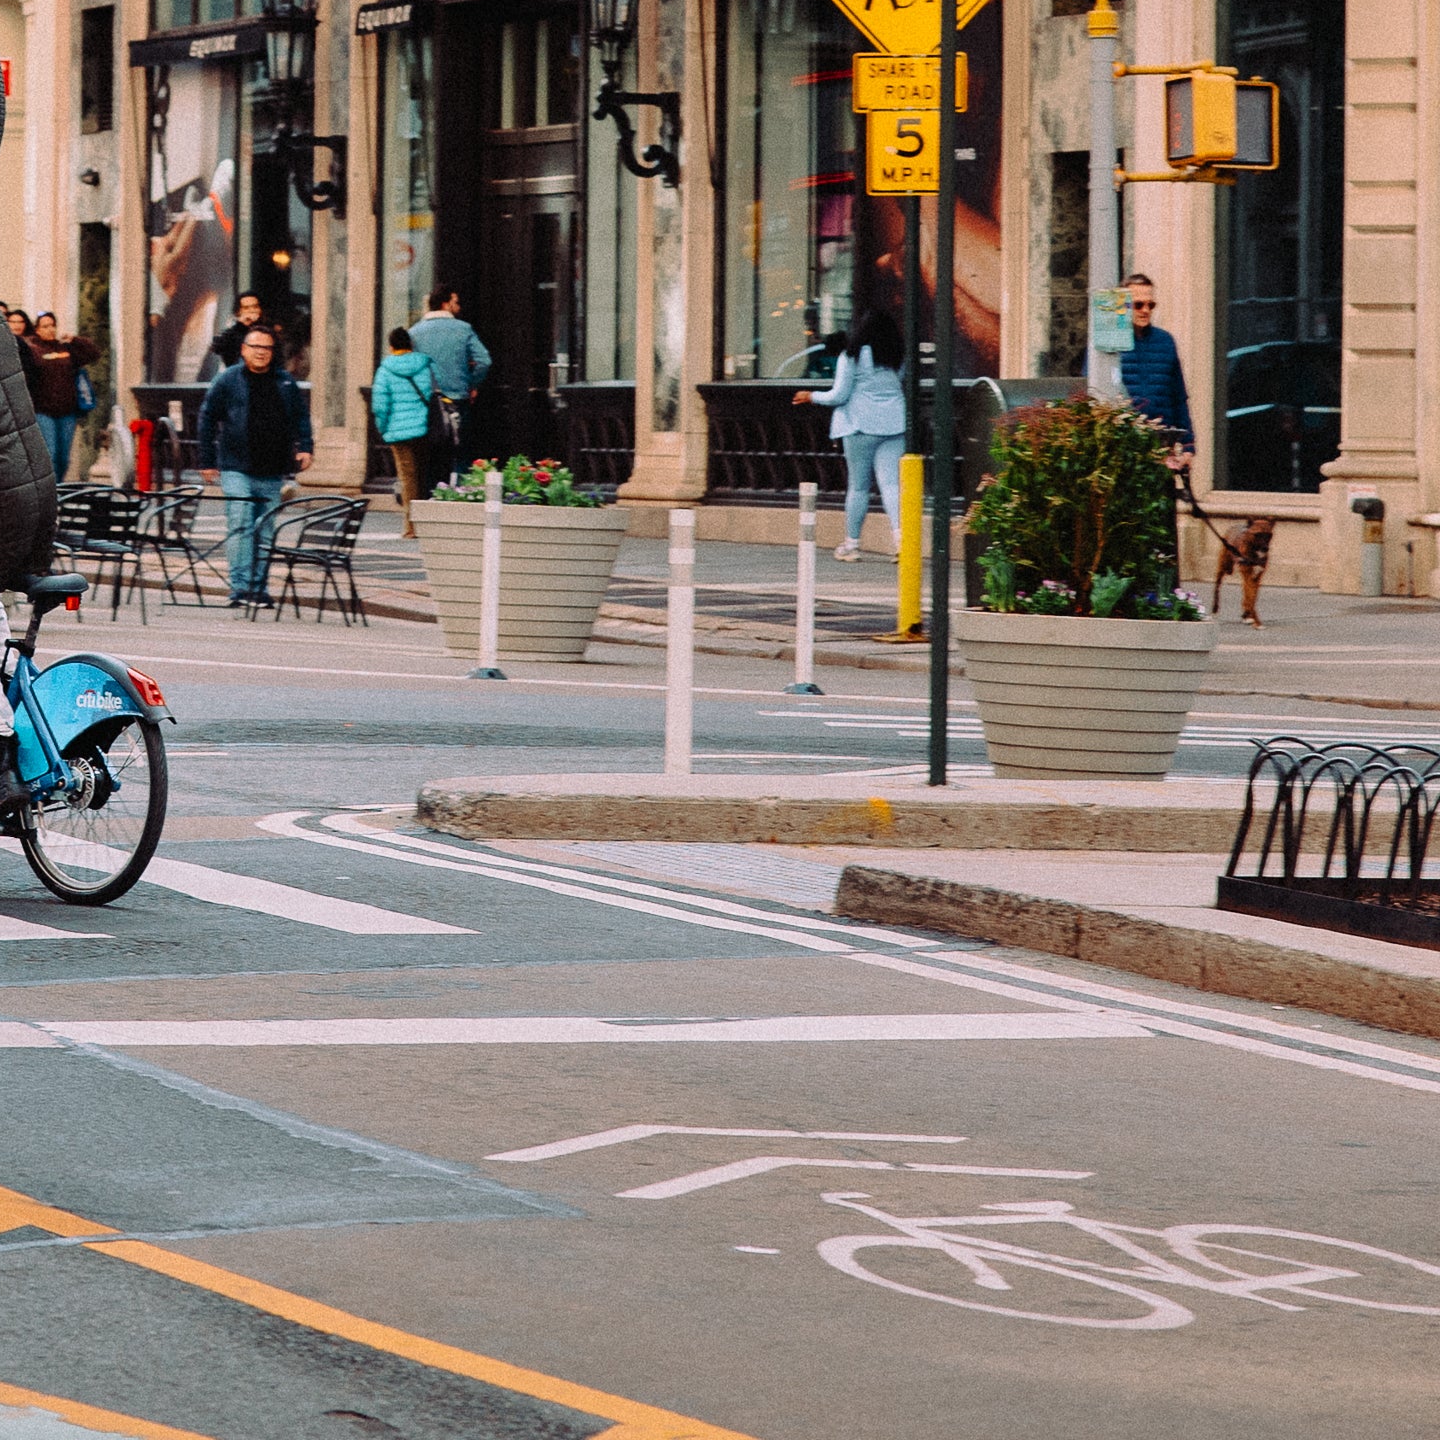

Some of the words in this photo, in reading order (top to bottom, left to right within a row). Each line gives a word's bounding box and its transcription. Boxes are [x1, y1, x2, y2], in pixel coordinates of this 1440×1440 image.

[357, 4, 412, 31] EQUINOX
[189, 34, 237, 59] EQUINOX
[868, 62, 916, 78] SHARE
[922, 62, 941, 78] TH
[884, 84, 935, 100] ROAD
[894, 117, 925, 158] 5
